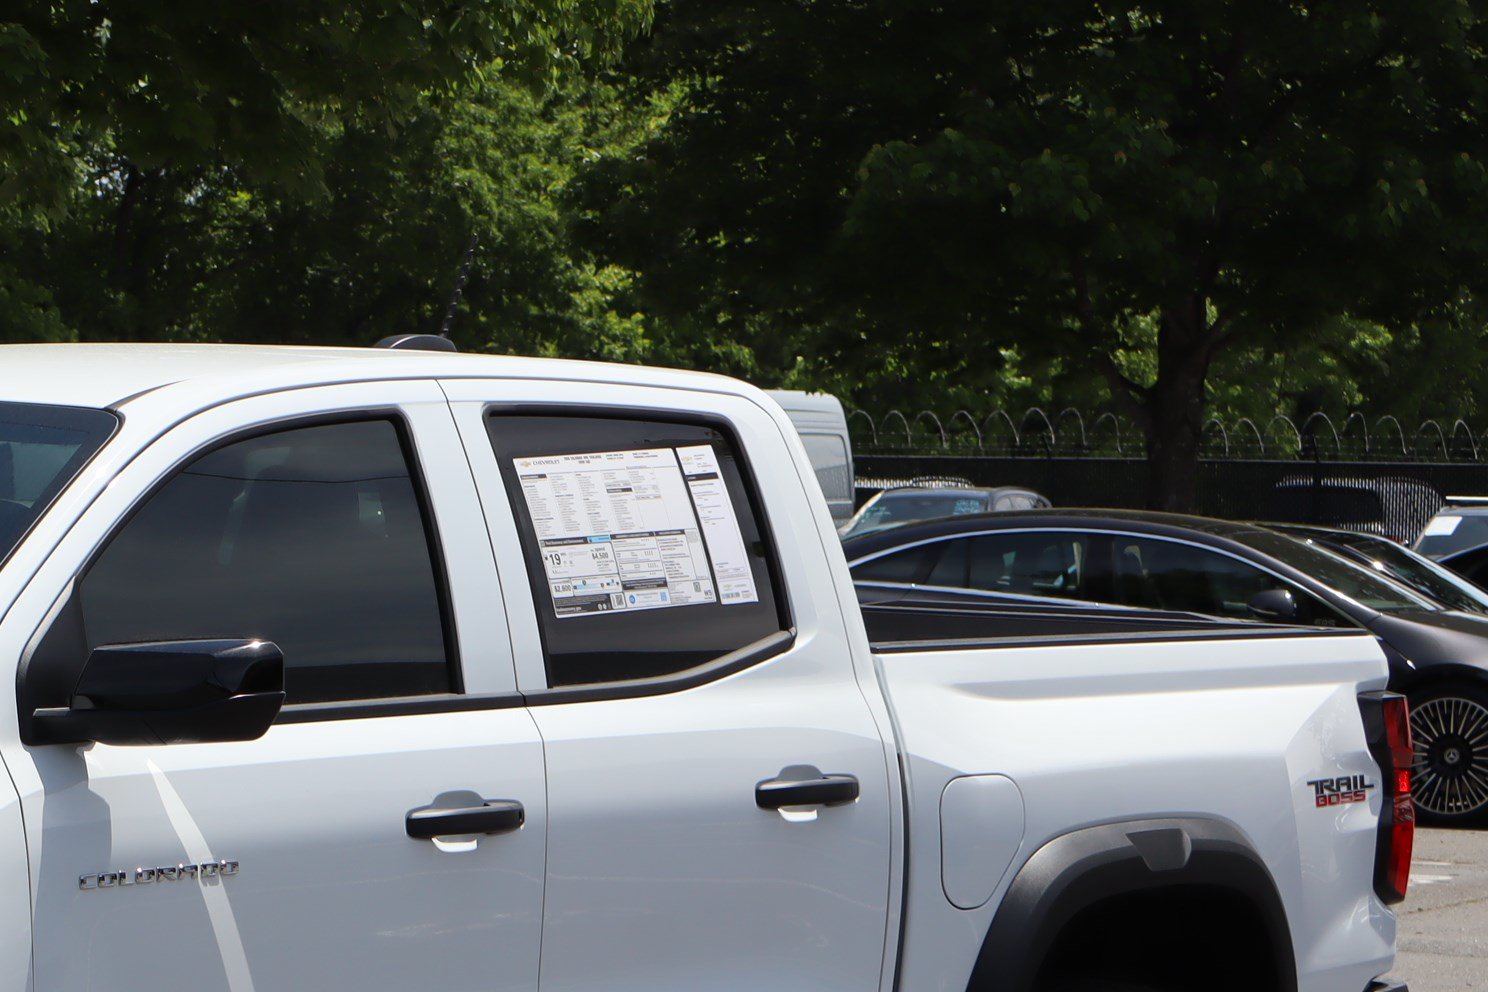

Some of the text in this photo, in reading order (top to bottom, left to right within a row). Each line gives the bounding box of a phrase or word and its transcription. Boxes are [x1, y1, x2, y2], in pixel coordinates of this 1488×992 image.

[549, 553, 561, 566] 19
[1307, 774, 1375, 795] TRAIL
[1315, 789, 1367, 808] BOSS
[79, 859, 240, 890] COLORADO
